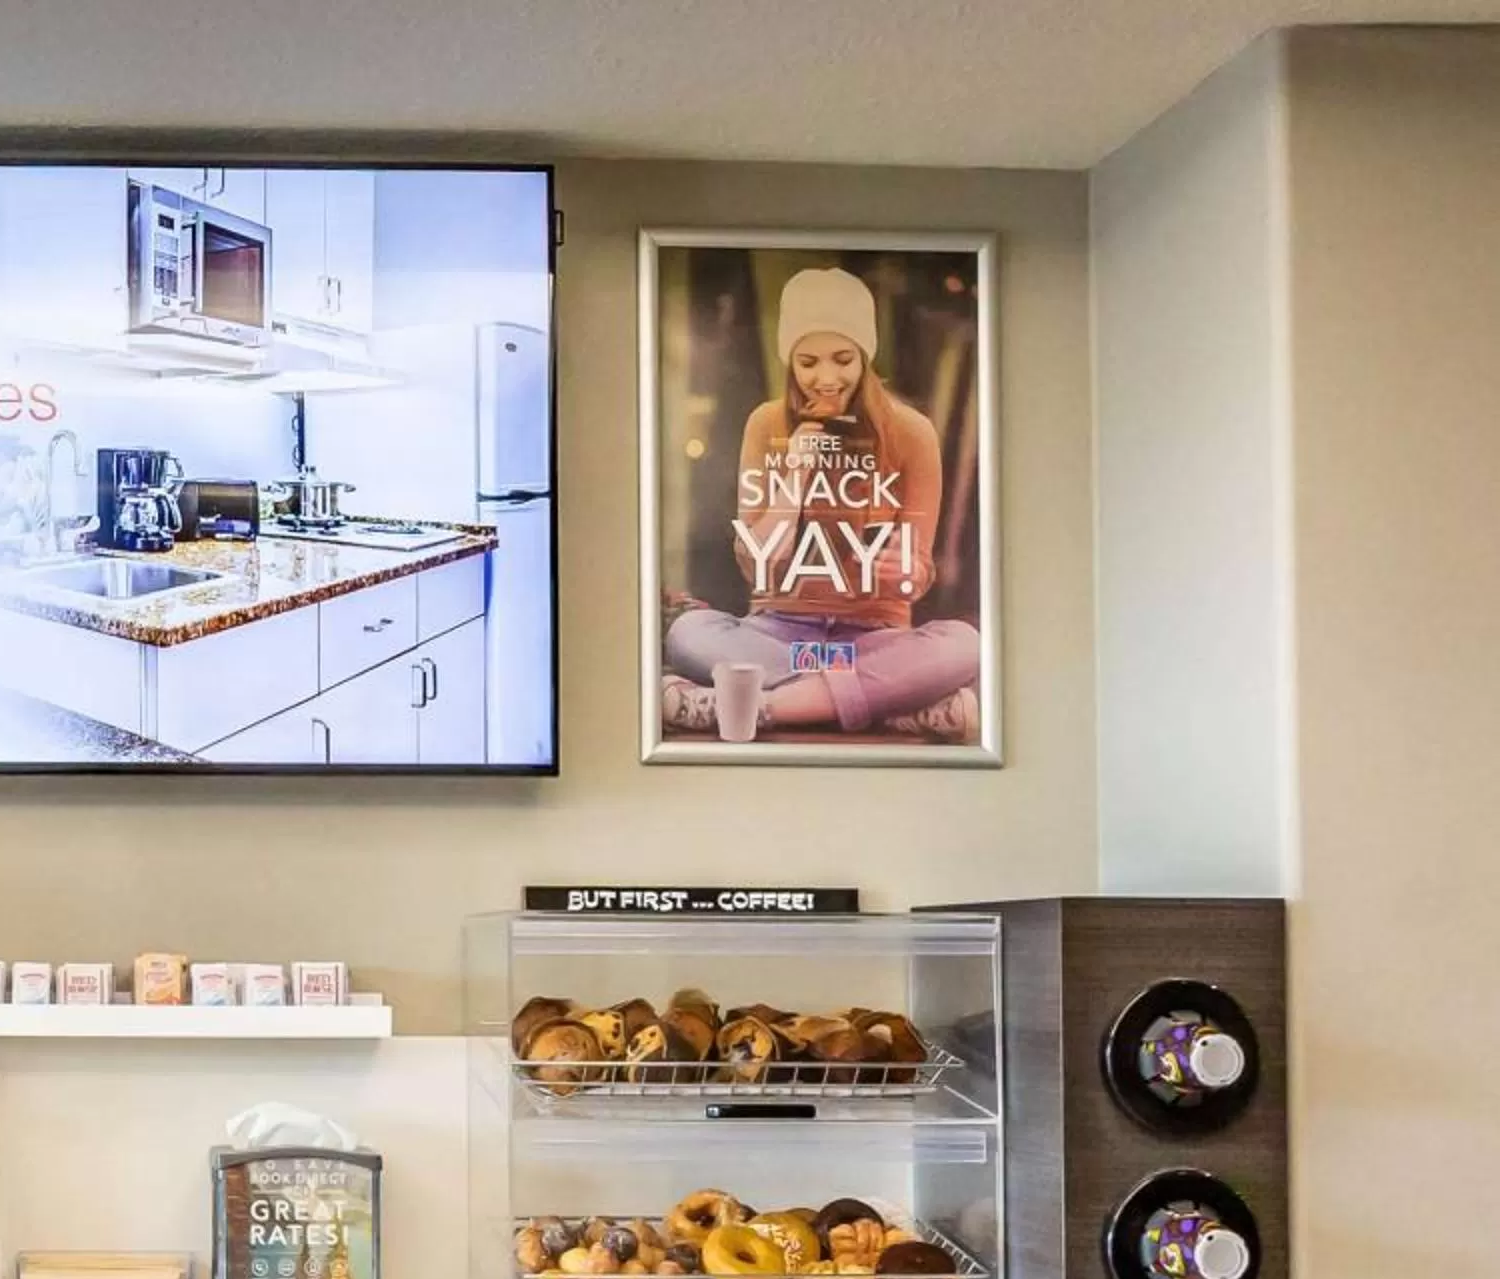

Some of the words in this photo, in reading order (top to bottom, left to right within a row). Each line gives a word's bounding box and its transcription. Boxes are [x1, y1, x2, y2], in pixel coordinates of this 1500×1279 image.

[799, 435, 843, 451] FREE
[765, 453, 877, 471] MORNING
[740, 469, 902, 509] SNACK
[732, 519, 914, 595] YAY!
[567, 890, 617, 911] BUT
[620, 890, 688, 911] FIRST
[717, 891, 815, 912] COFFEE!
[250, 1199, 348, 1222] GREAT
